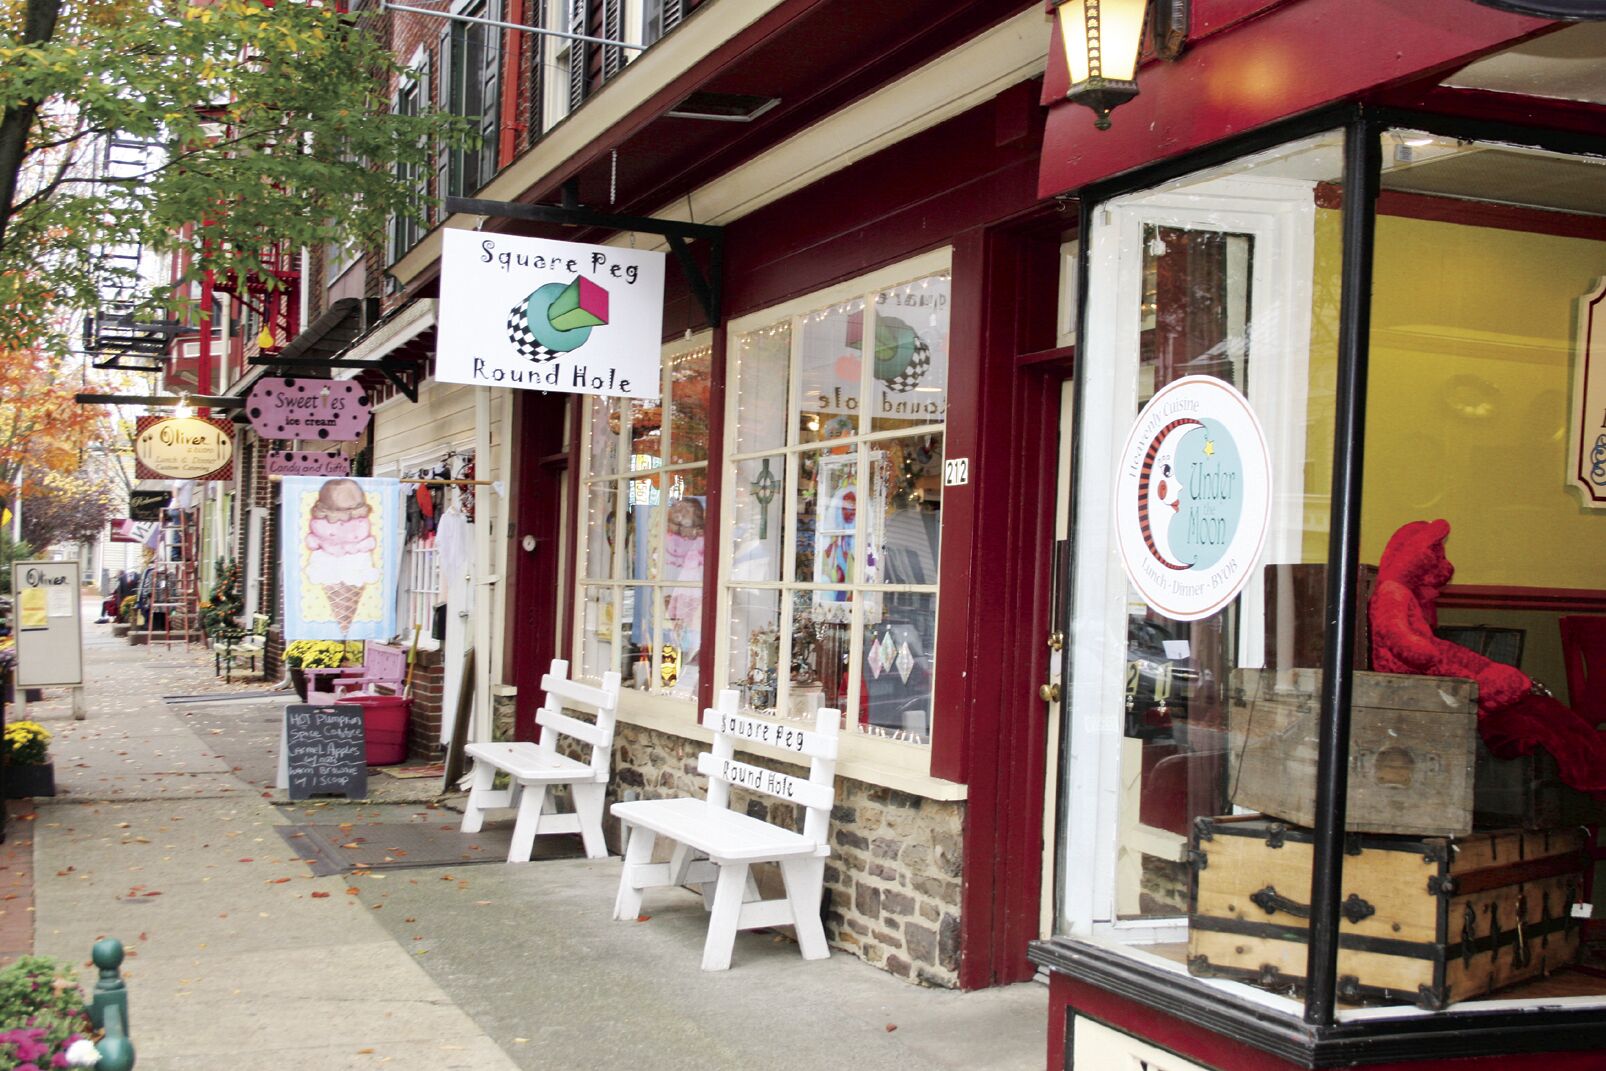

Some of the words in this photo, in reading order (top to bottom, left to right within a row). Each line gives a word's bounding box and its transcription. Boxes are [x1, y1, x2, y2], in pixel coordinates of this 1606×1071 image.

[481, 239, 578, 273] Square
[591, 252, 639, 285] Peg
[473, 357, 560, 386] Round
[572, 365, 632, 393] Hole
[285, 416, 301, 426] ice
[304, 418, 337, 426] cream
[1163, 397, 1200, 417] Cuisine
[269, 461, 300, 476] Candy
[302, 462, 320, 472] and
[325, 461, 347, 473] Gifts
[946, 460, 967, 485] 212
[1190, 461, 1236, 500] Under
[1187, 506, 1226, 545] Moon
[1141, 556, 1167, 589] Lunch
[1173, 580, 1206, 597] Dinner
[1211, 558, 1239, 589] BYOB
[720, 713, 769, 741] Square
[776, 725, 804, 751] Peg
[722, 760, 763, 788] Round
[767, 773, 794, 797] Hole
